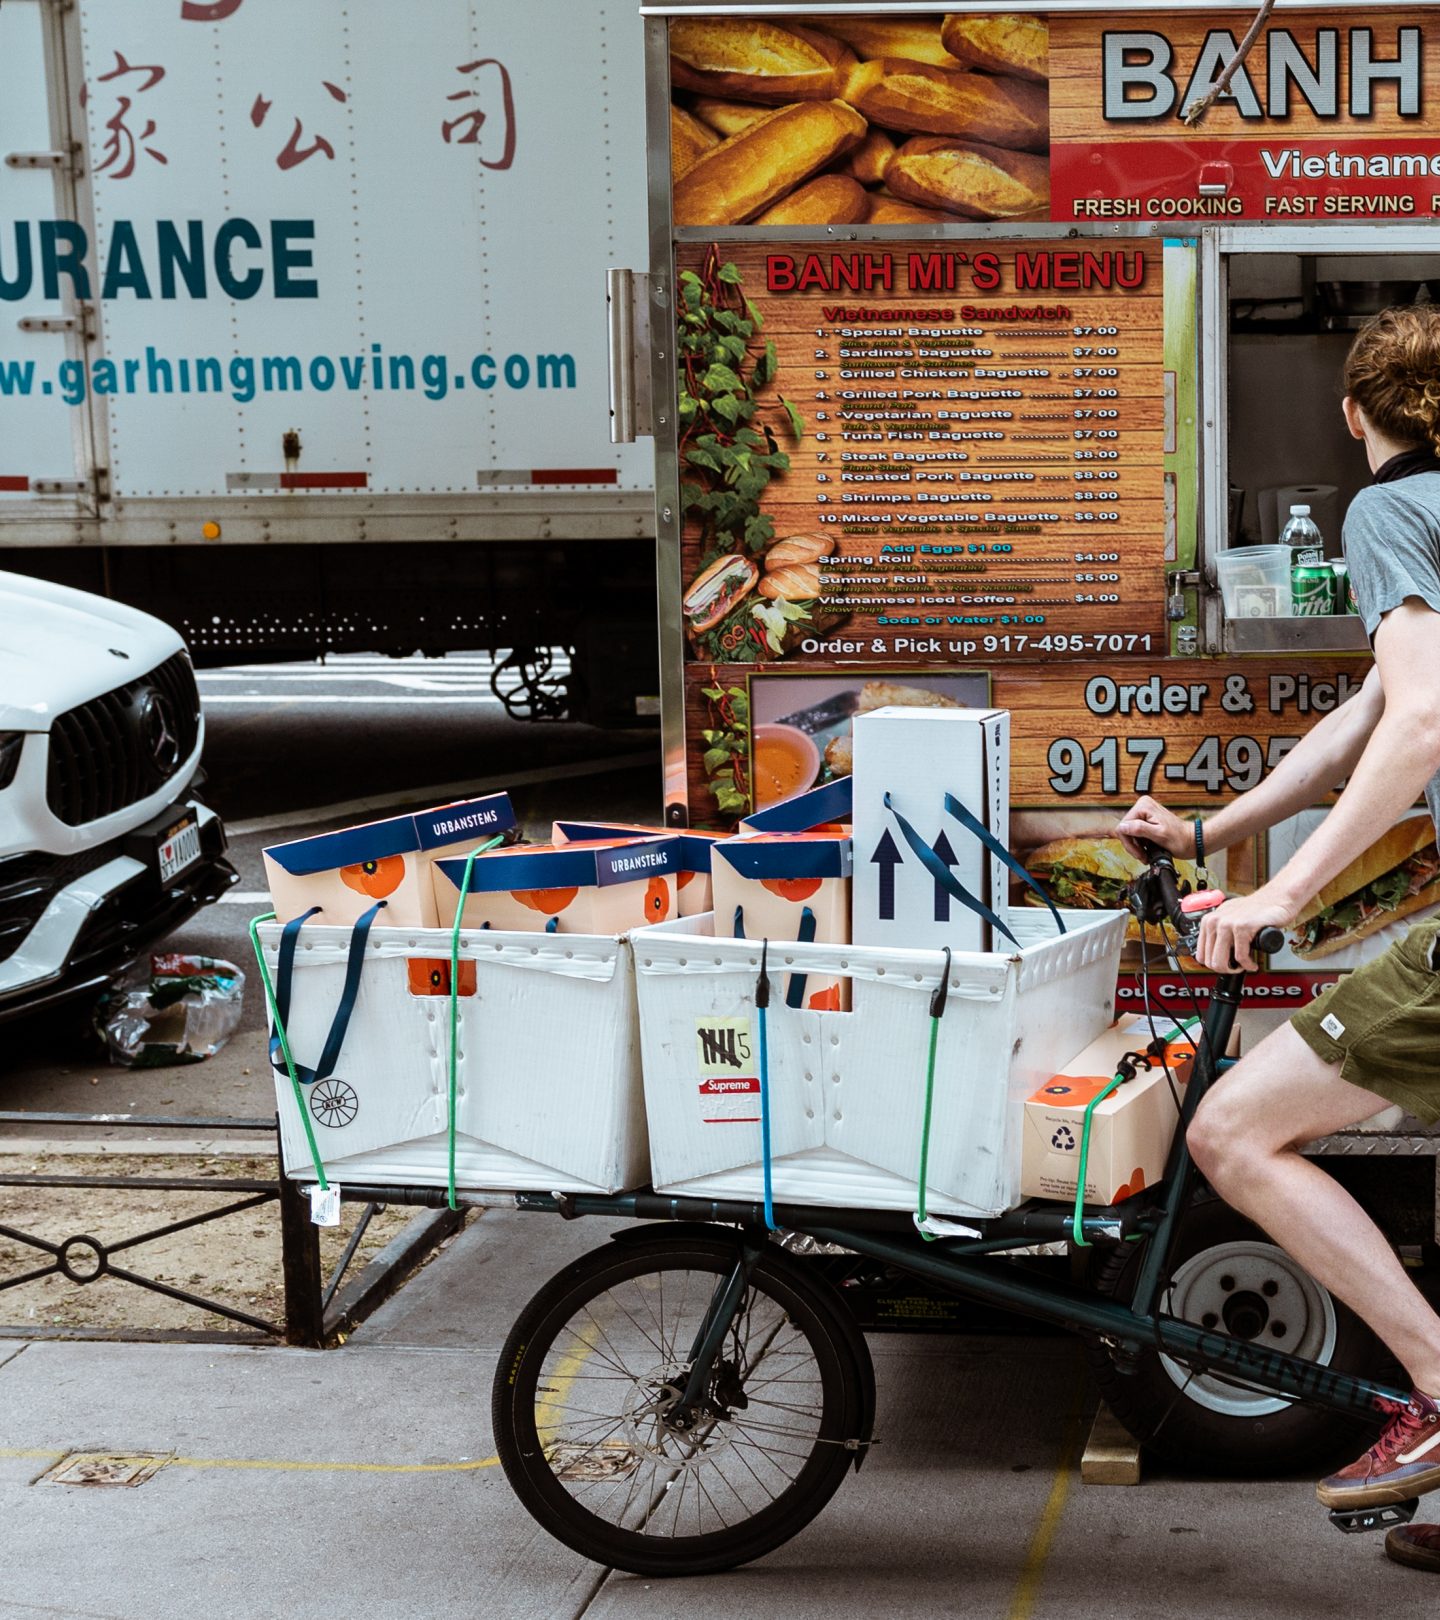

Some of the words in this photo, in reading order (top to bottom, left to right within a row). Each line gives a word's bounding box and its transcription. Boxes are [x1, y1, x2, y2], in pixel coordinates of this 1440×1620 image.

[1102, 27, 1421, 120] BANH
[1073, 199, 1141, 216] FRESH
[1151, 197, 1242, 216] COOKING
[1265, 197, 1317, 214] FAST
[1324, 195, 1414, 214] SERVING
[766, 254, 892, 291] BANH
[1015, 251, 1144, 289] MENU
[822, 306, 953, 322] Vietnamese
[961, 305, 1071, 321] Sandwich
[908, 328, 984, 338] Baguette
[1073, 327, 1118, 336] $7.00
[840, 349, 914, 358] Sardines
[919, 349, 993, 358] baguette
[1073, 347, 1118, 357] $7.00
[840, 370, 896, 378] Grilled
[901, 369, 969, 378] Chicken
[974, 369, 1049, 379] Baguette
[1073, 368, 1118, 377] $7.00
[903, 390, 941, 398] Pork
[947, 390, 1023, 399] Baguette
[1073, 389, 1118, 397] $7.00
[937, 411, 1013, 420] Baguette
[1073, 409, 1118, 418] $7.00
[841, 432, 882, 440] Tuna
[888, 432, 923, 440] Fish
[929, 431, 1004, 441] Baguette
[1074, 430, 1118, 439] $7.00
[841, 452, 888, 461] Steak
[893, 452, 968, 462] Baguette
[1074, 450, 1118, 459] $8.00
[841, 473, 910, 481] Roasted
[916, 473, 954, 481] Pork
[960, 472, 1035, 482] Baguette
[1074, 471, 1119, 480] $8.00
[841, 493, 911, 503] Shrimps
[917, 493, 992, 502] Baguette
[1074, 491, 1119, 500] $8.00
[897, 514, 979, 523] Vegetable
[984, 513, 1059, 523] Baguette
[1074, 512, 1119, 521] $6.00
[882, 544, 915, 553] Add
[921, 544, 963, 554] Eggs
[968, 543, 1012, 553] $1.00
[818, 556, 873, 565] Spring
[879, 555, 911, 563] Roll
[1074, 553, 1119, 562] $4.00
[818, 576, 888, 584] Summer
[893, 575, 926, 584] Roll
[818, 596, 916, 605] Vietnamese
[921, 596, 955, 604] Iced
[961, 595, 1015, 604] Coffee
[1074, 594, 1119, 603] $4.00
[877, 616, 919, 625] Soda
[925, 617, 943, 625] or
[947, 616, 996, 625] Water
[1001, 615, 1045, 624] $1.00
[801, 637, 864, 655] Order
[871, 637, 887, 654] &
[894, 636, 944, 654] Pick
[949, 641, 977, 657] up
[983, 634, 1152, 653] 917-495-7071
[1085, 676, 1207, 715] Order
[1221, 674, 1254, 714] &
[433, 810, 497, 836] URBANSTEMS
[611, 852, 668, 873] URBANSTEMS
[1159, 984, 1209, 998] Can
[738, 1032, 750, 1059] 5
[708, 1080, 750, 1093] Supreme
